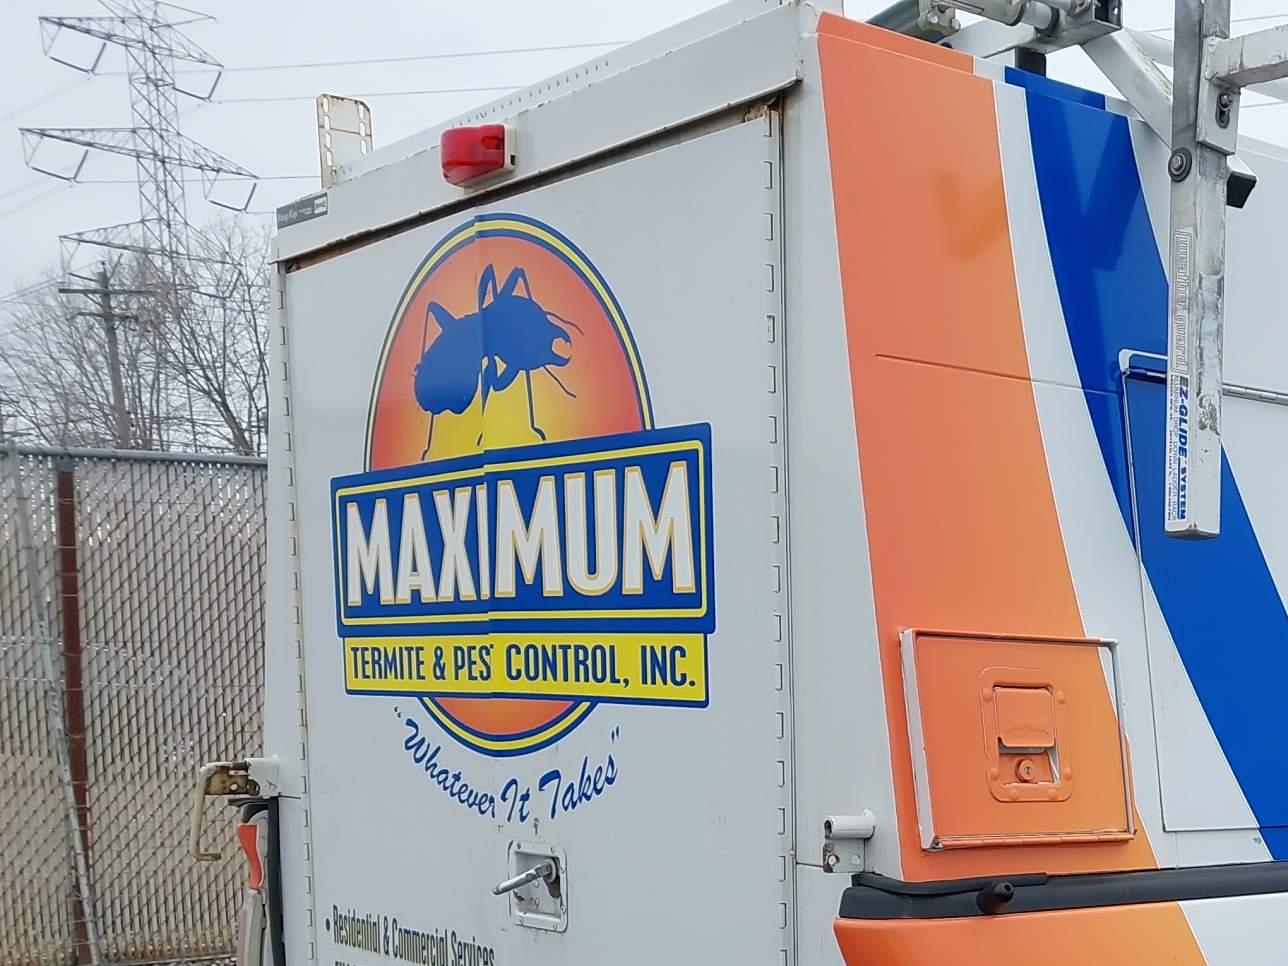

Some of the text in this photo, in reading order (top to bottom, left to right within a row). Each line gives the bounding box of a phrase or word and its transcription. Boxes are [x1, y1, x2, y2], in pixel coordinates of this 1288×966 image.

[345, 460, 697, 607] MAXIMUM
[350, 643, 697, 688] TERMITE & PES CONTROL, INC.
[501, 778, 530, 822] It
[332, 904, 381, 955] Residential
[383, 916, 390, 956] &
